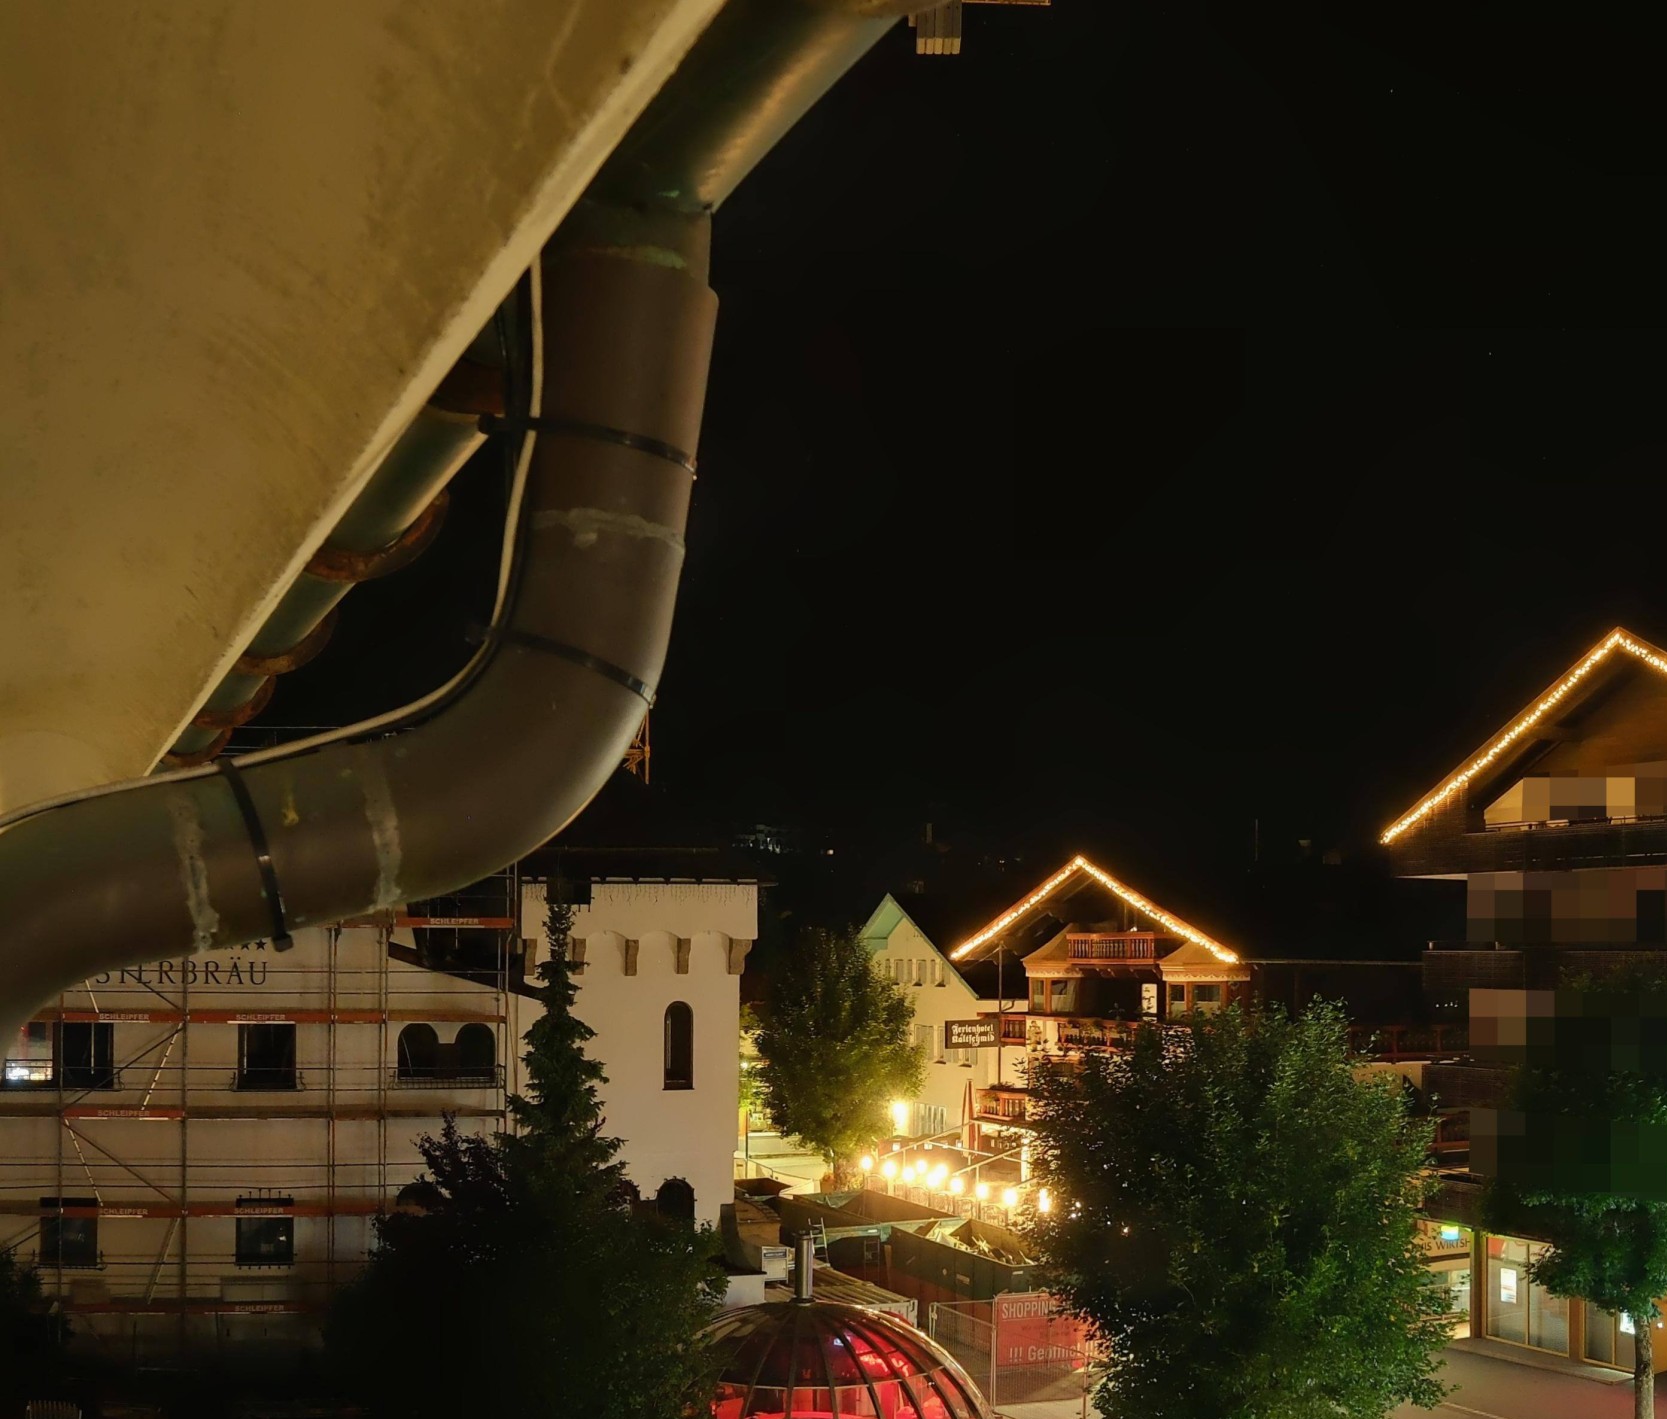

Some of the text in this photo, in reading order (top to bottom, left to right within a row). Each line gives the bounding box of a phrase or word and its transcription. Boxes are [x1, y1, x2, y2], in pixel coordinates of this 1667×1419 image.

[430, 917, 479, 925] SCHLEIPFER
[86, 956, 268, 986] STERBRÄU
[98, 1109, 150, 1117] SCHLEIPFER
[99, 1208, 148, 1216] SCHLEIPFER
[234, 1207, 284, 1215] SCHLEIPFER
[235, 1304, 285, 1312] SCHLEIPFER
